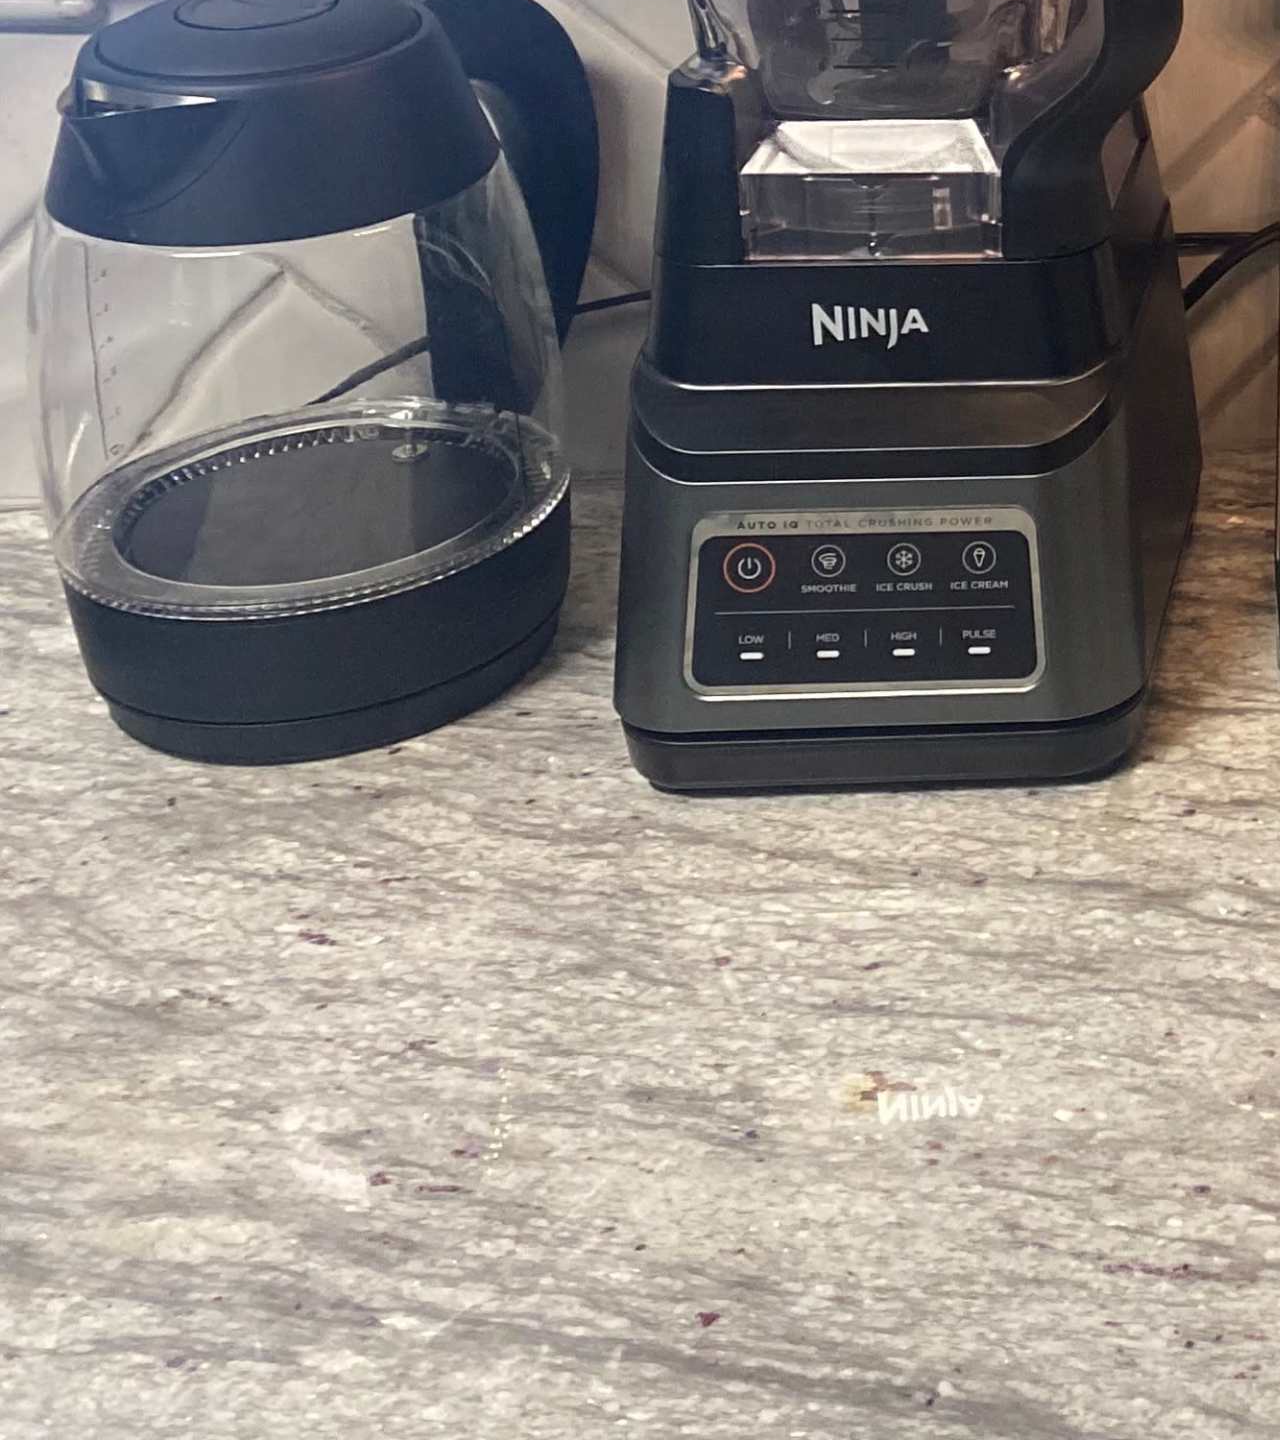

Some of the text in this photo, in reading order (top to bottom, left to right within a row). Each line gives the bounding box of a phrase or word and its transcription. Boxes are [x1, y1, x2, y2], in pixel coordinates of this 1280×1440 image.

[811, 302, 930, 350] NINJA
[737, 520, 777, 530] AUTO
[806, 519, 850, 529] TOTAL
[858, 517, 933, 528] CRUSHING
[940, 516, 992, 526] POWER
[801, 583, 857, 594] SMOOTHIE
[876, 582, 933, 592] ICE CRUSH
[951, 579, 1009, 590] ICE CREAM
[738, 634, 765, 645] LOW
[815, 633, 840, 643] MED
[891, 631, 917, 641] HIGH
[962, 628, 997, 640] PULSE
